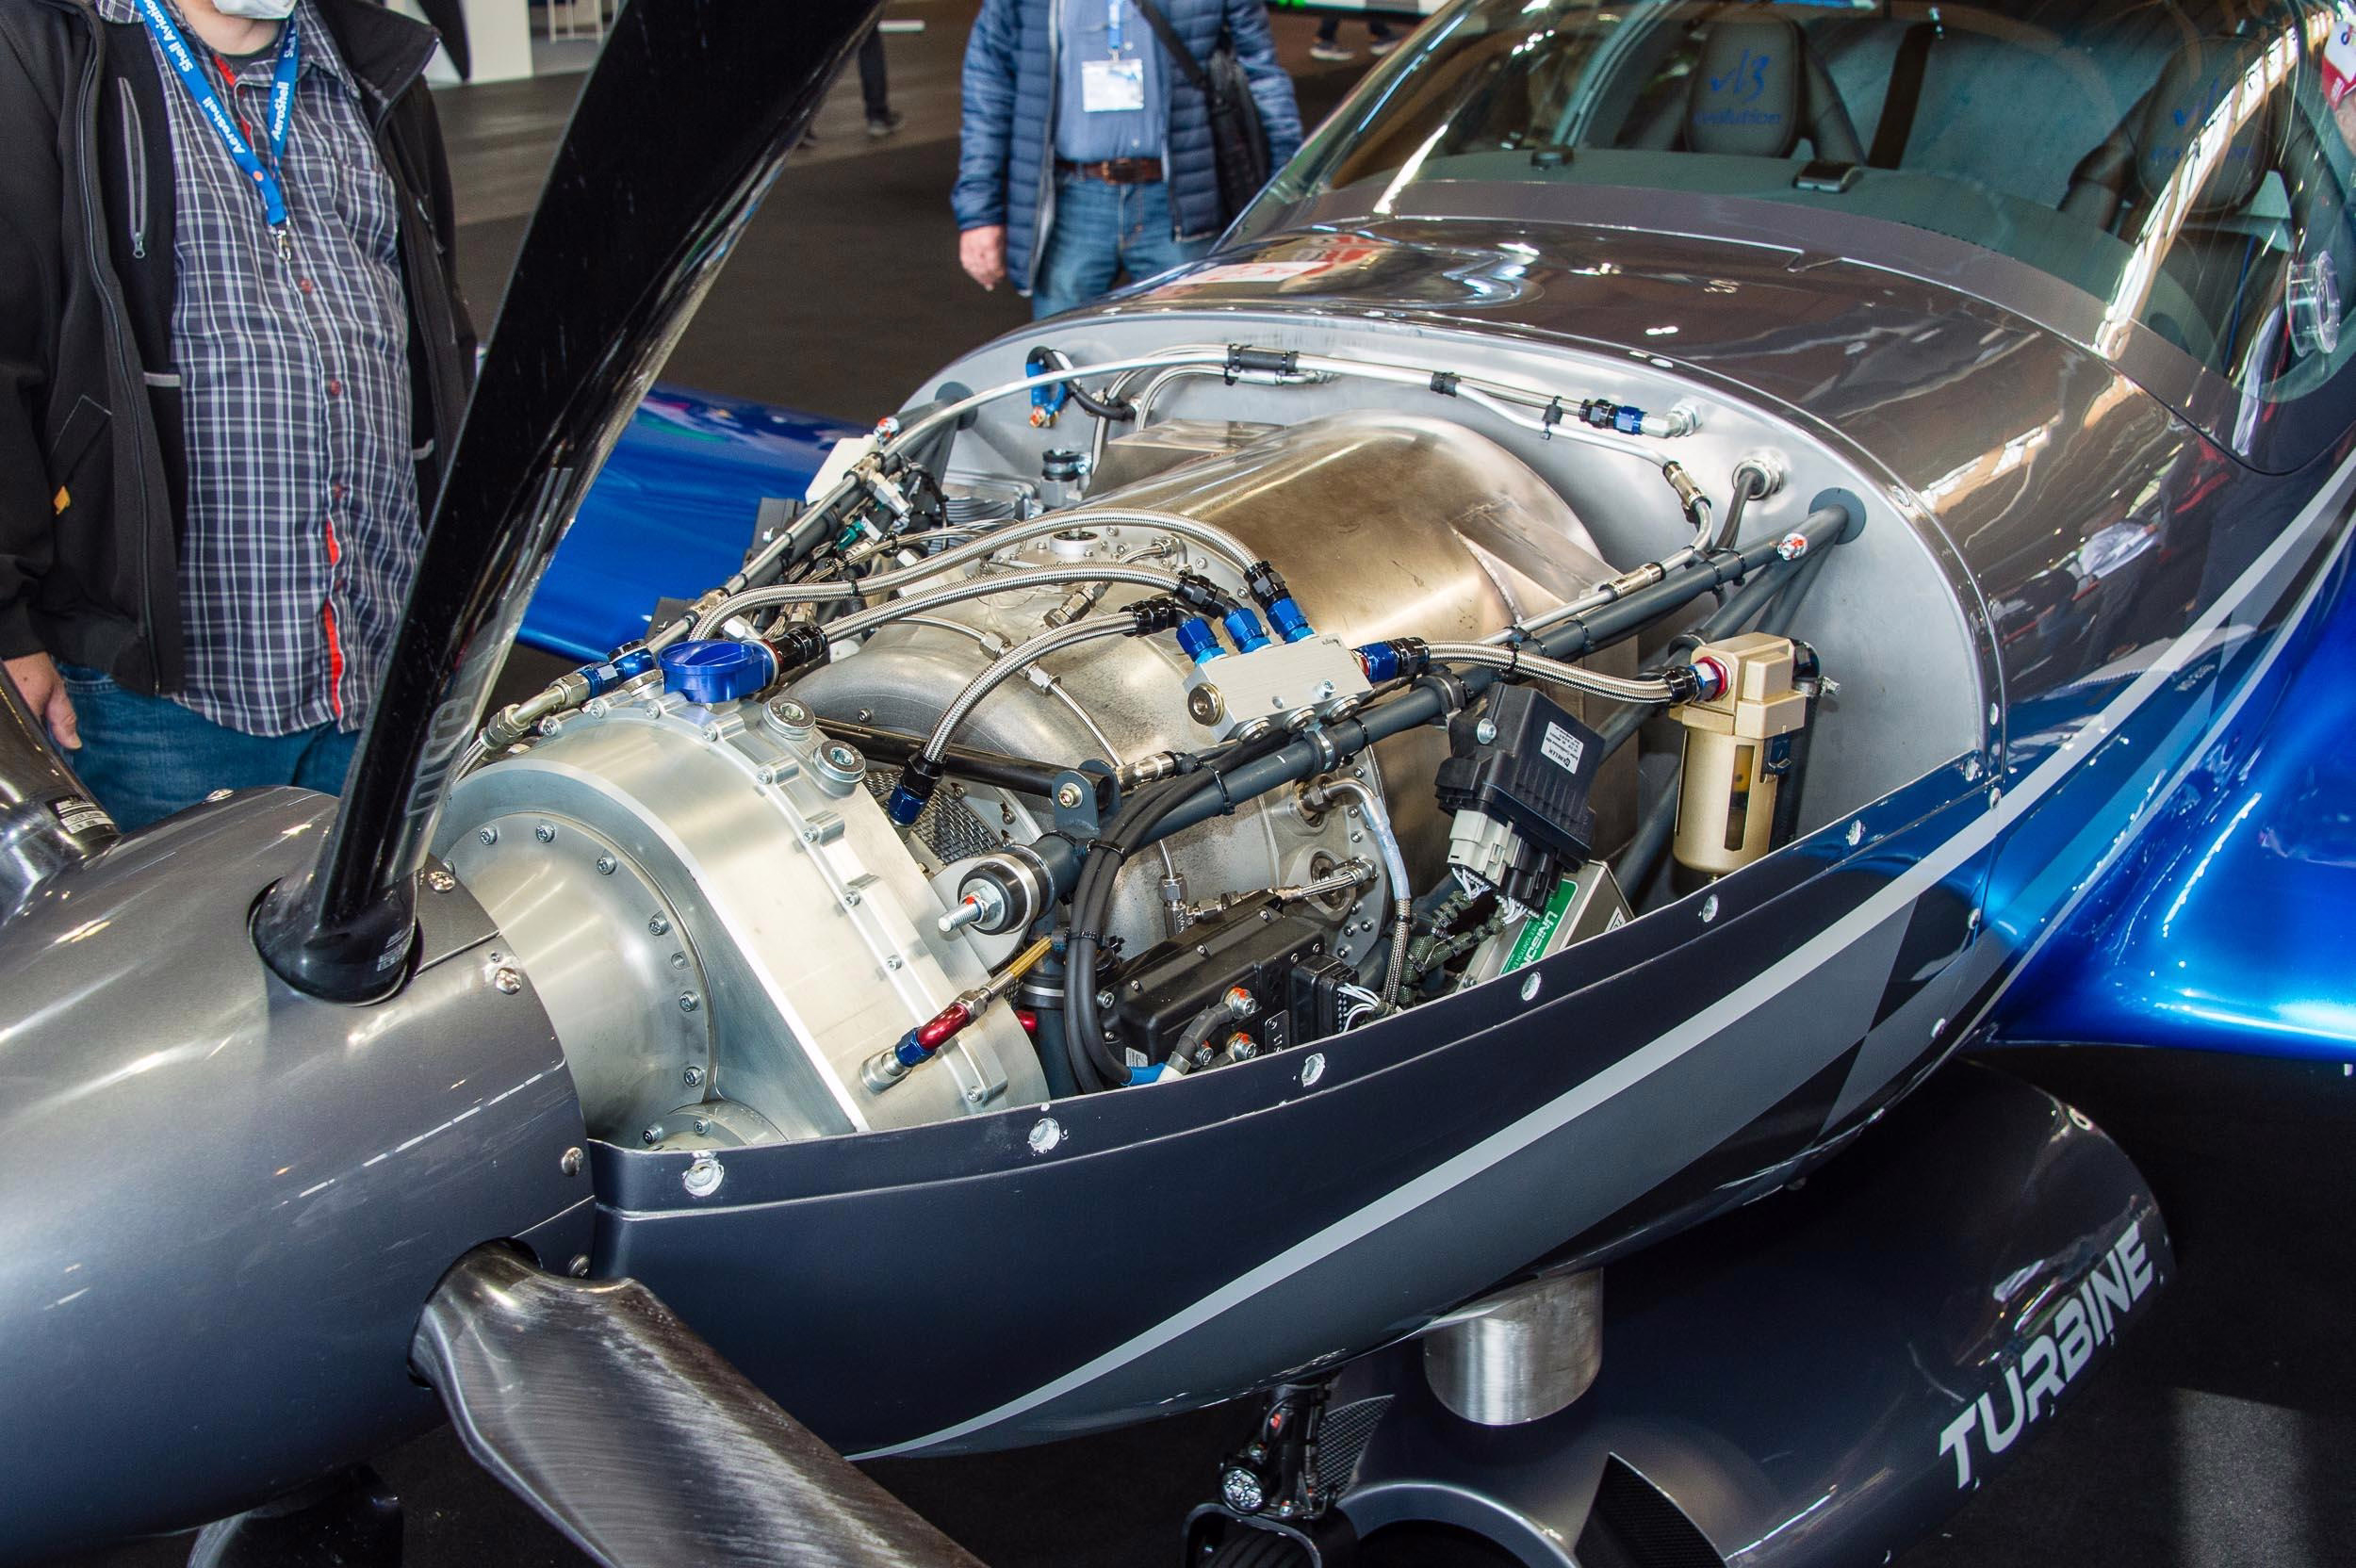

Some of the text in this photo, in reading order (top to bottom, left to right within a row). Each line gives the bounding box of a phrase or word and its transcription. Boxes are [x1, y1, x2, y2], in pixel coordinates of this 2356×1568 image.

[143, 0, 194, 73] Shell Aviatio
[202, 96, 246, 154] AeroShell
[270, 81, 290, 141] AeroShell
[1939, 1220, 2153, 1490] TURBINE
